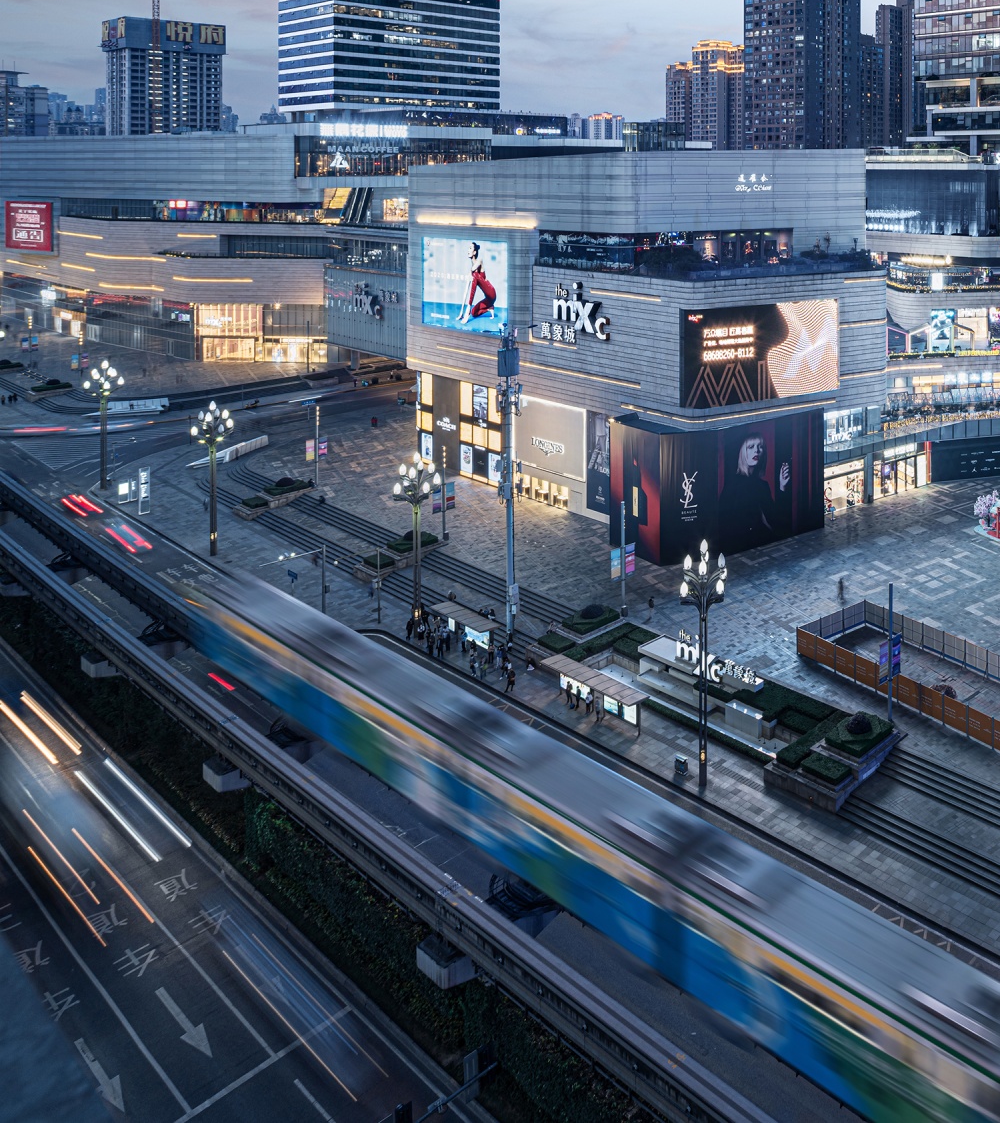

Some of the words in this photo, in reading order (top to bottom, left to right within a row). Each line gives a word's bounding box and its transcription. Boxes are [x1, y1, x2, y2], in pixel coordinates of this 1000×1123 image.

[555, 282, 568, 298] the
[540, 321, 577, 344] 萬象城
[436, 420, 457, 431] COACH
[531, 436, 564, 455] LONGINES
[679, 629, 691, 641] the
